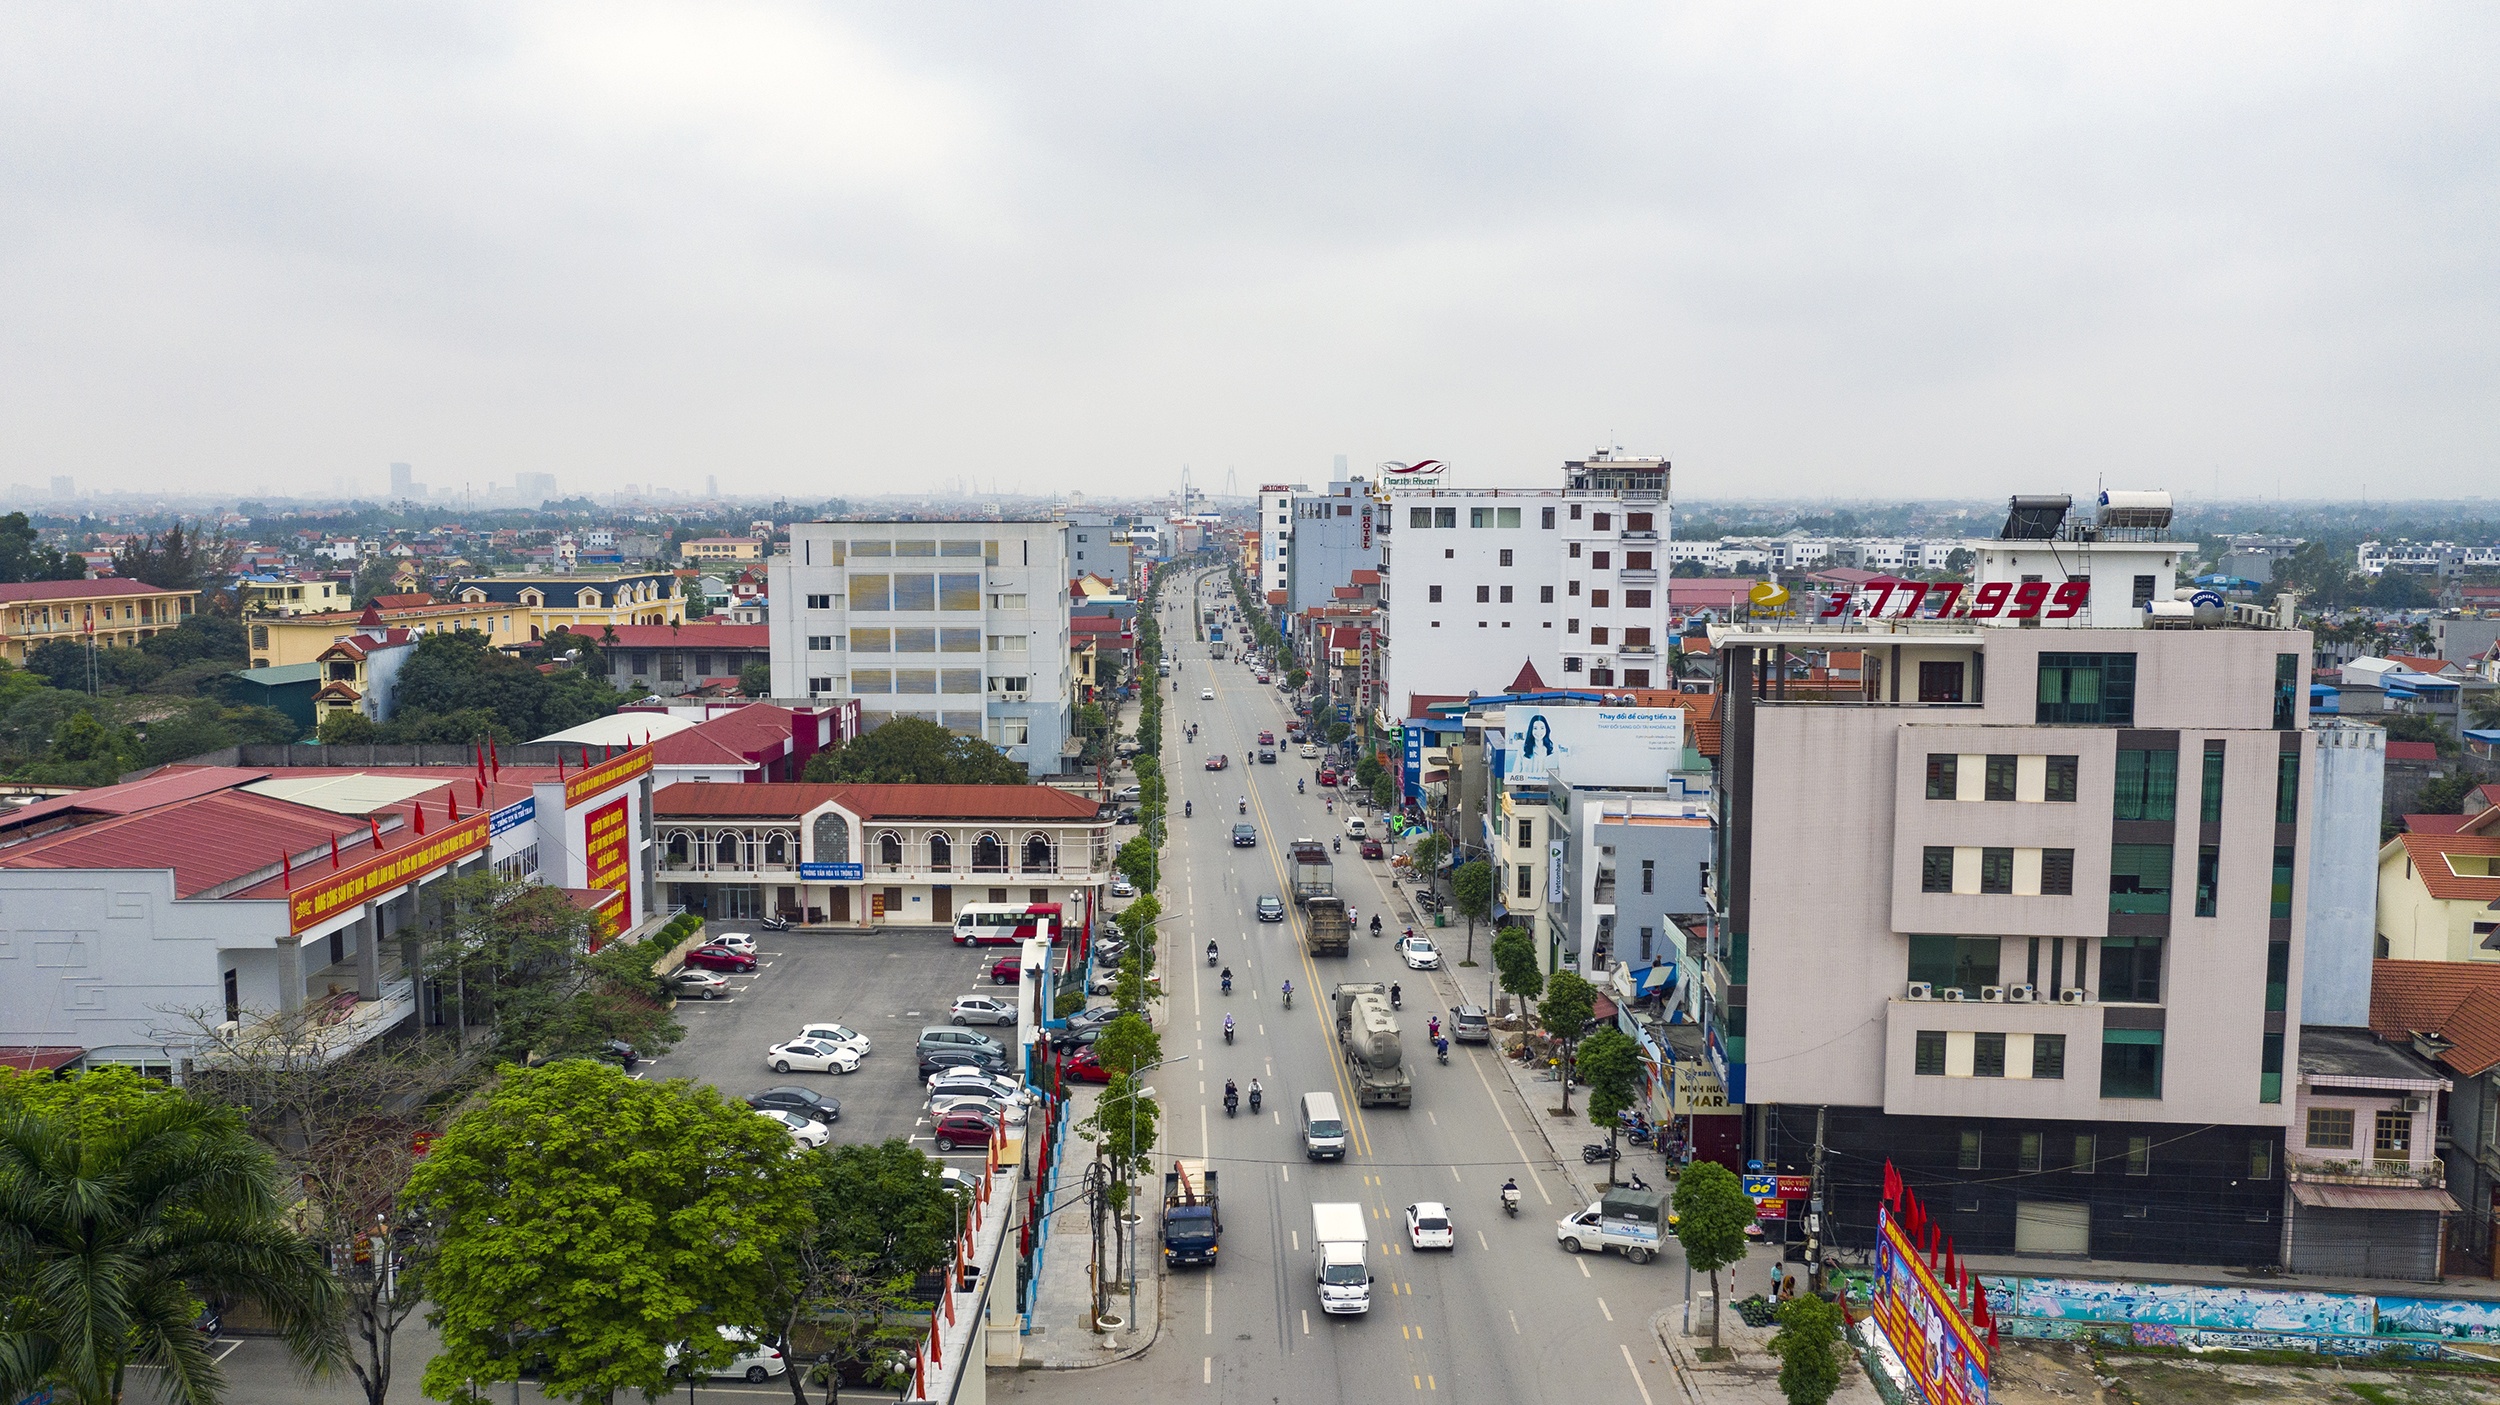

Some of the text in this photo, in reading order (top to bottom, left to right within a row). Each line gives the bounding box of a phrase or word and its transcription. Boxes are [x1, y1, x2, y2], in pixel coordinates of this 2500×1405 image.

[1383, 477, 1438, 485] North River
[1362, 516, 1371, 549] HOTEL
[1820, 582, 2091, 619] 3.777.999
[1361, 644, 1371, 706] APARTMENT
[1598, 713, 1615, 721] Thay
[1616, 712, 1627, 720] đổi
[1628, 712, 1636, 720] để
[1636, 713, 1653, 721] cùng
[1408, 750, 1418, 758] ĐỨC
[1406, 761, 1420, 770] TRỌNG
